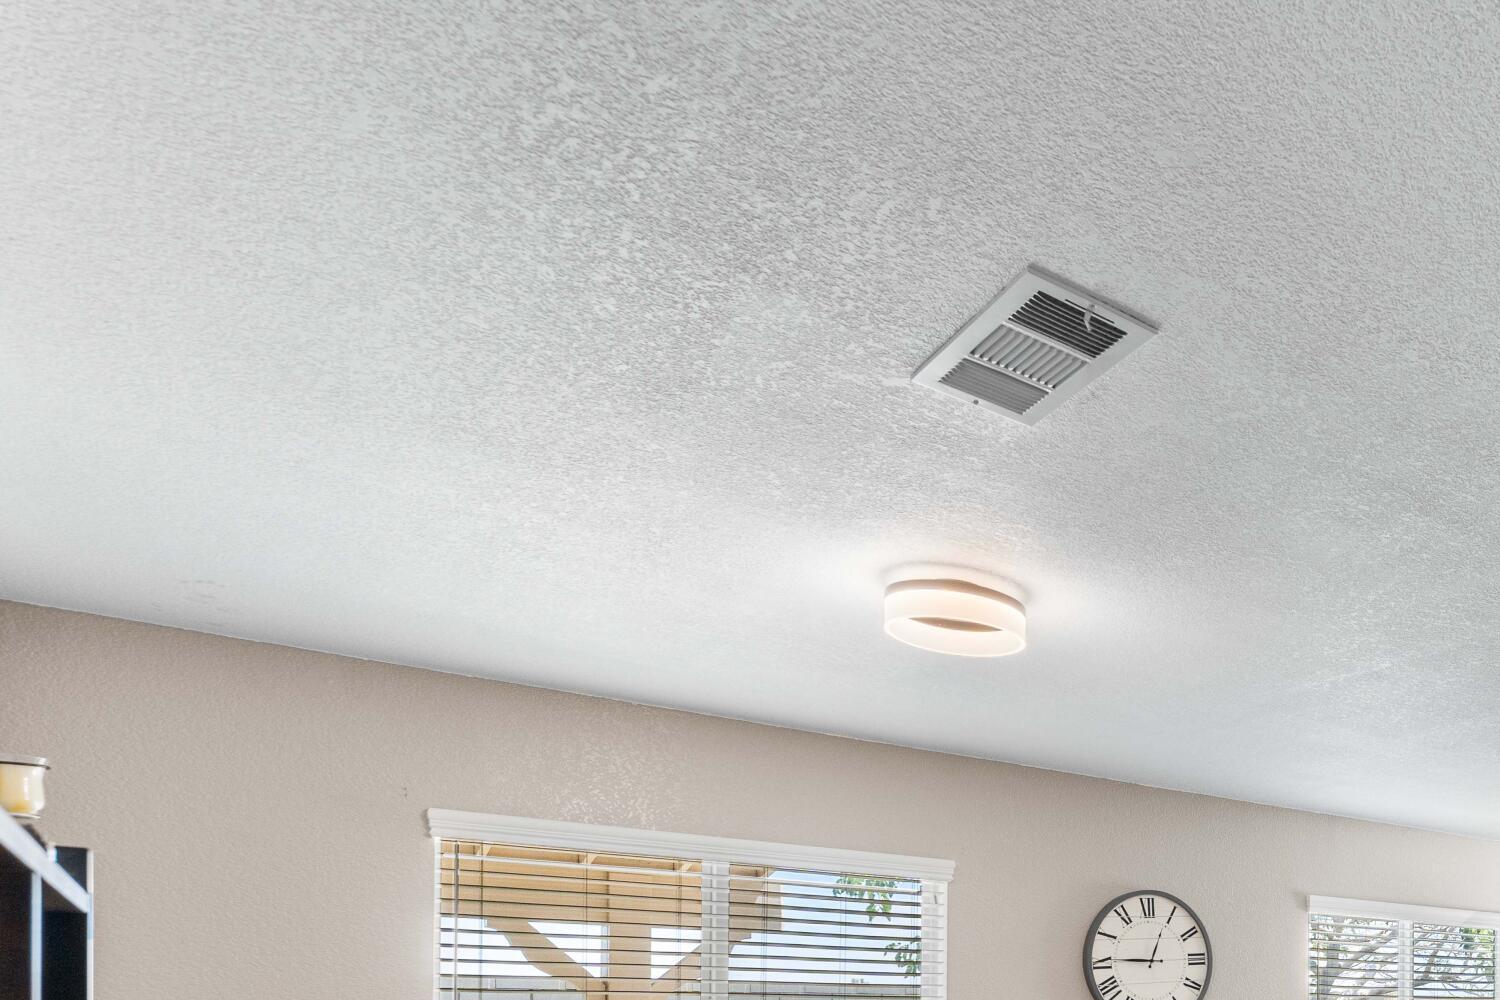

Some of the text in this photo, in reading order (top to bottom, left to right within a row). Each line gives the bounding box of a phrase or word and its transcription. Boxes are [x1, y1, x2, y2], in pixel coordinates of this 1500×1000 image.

[1112, 903, 1134, 929] XI
[1137, 897, 1155, 919] XII
[1166, 905, 1178, 925] I
[1180, 925, 1199, 942] II
[1187, 953, 1206, 966] III
